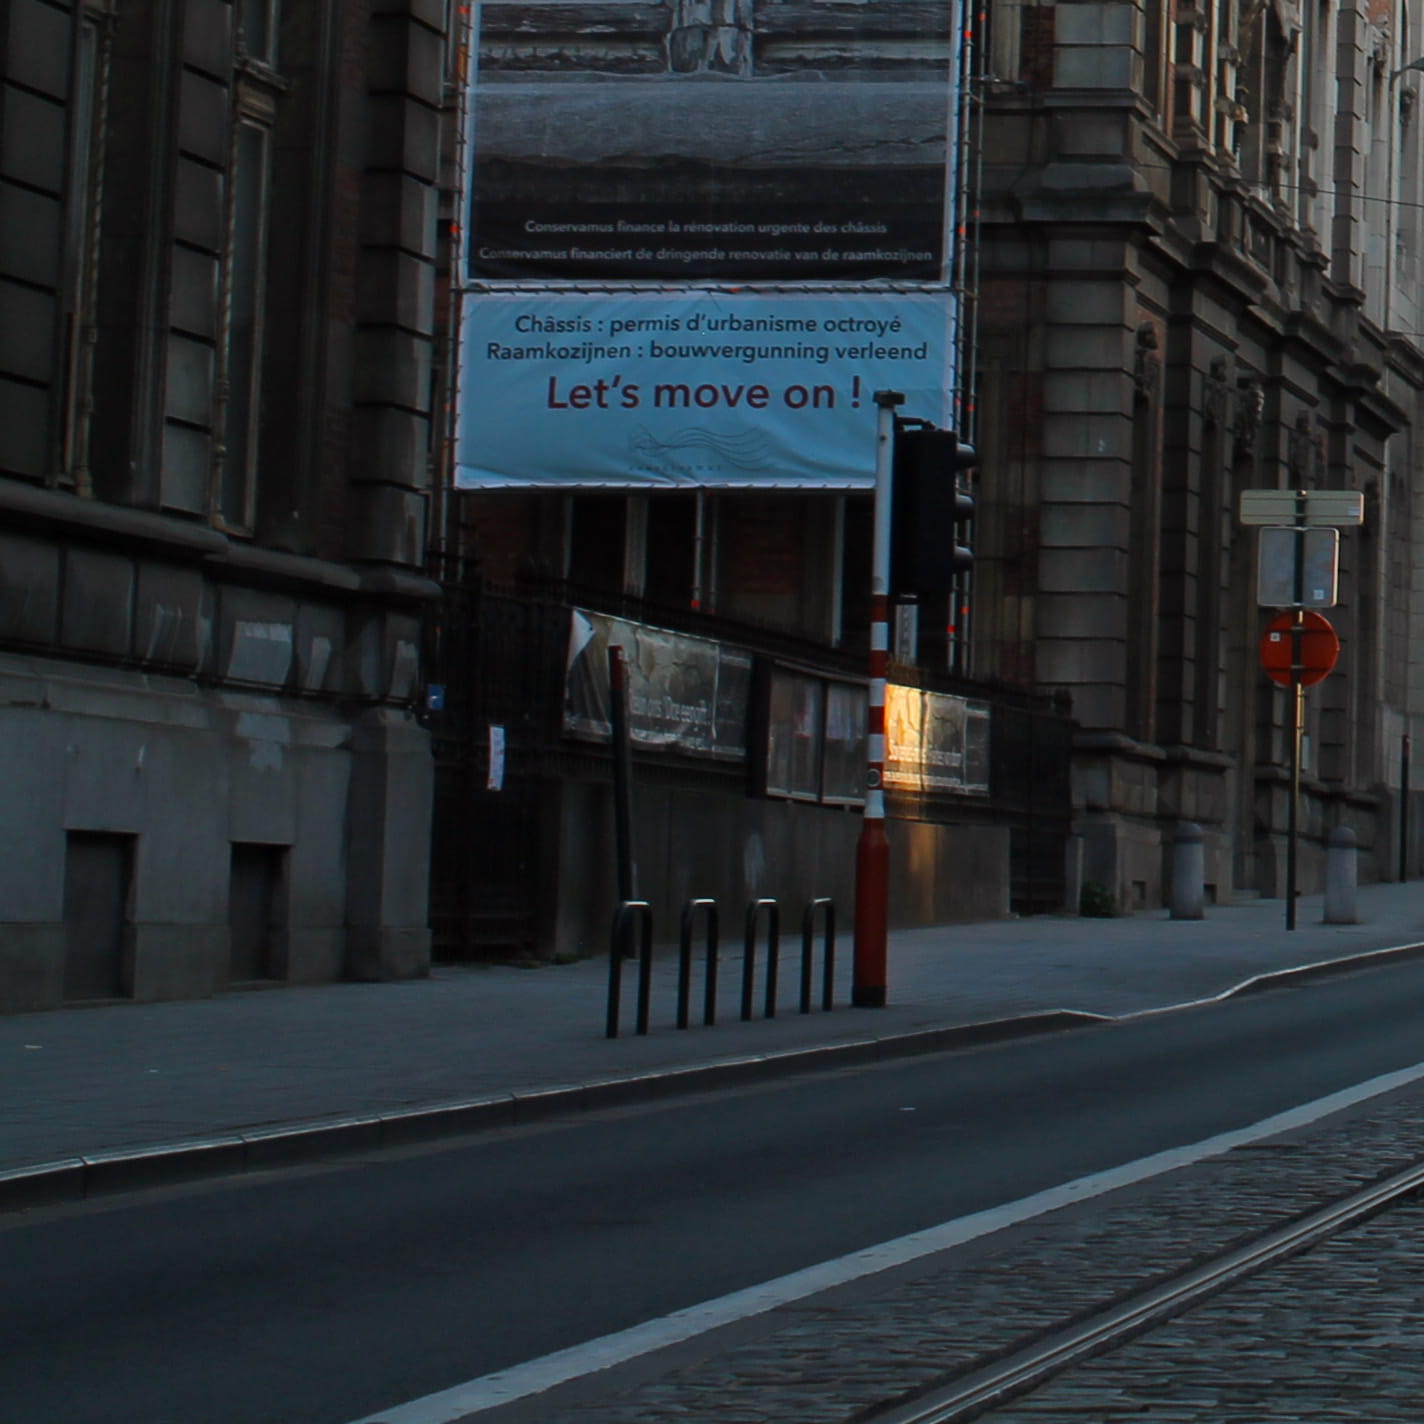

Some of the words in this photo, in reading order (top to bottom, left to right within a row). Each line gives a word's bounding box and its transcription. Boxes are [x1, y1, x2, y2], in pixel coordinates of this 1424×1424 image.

[524, 219, 614, 233] Conservamus
[616, 219, 665, 233] finance
[668, 219, 681, 233] la
[684, 220, 755, 233] rénovation
[758, 222, 811, 236] urgente
[813, 220, 837, 233] des
[840, 221, 888, 233] châssis
[479, 247, 567, 260] Conservamus
[570, 247, 632, 260] financiert
[635, 247, 652, 260] de
[655, 248, 725, 263] dringende
[728, 248, 791, 261] renovatie
[795, 250, 819, 261] van
[821, 248, 840, 261] de
[842, 248, 933, 264] raamkozijnen
[515, 315, 592, 333] Châssis
[610, 314, 681, 337] permis
[686, 313, 817, 332] d’urbanisme
[823, 315, 901, 337] octroyé
[487, 342, 631, 364] Raamkozijnen
[651, 340, 829, 364] bouwvergunning
[835, 342, 928, 360] verleend
[547, 375, 640, 409] Let’s
[654, 383, 770, 409] move
[784, 384, 834, 409] on
[851, 375, 861, 408] !
